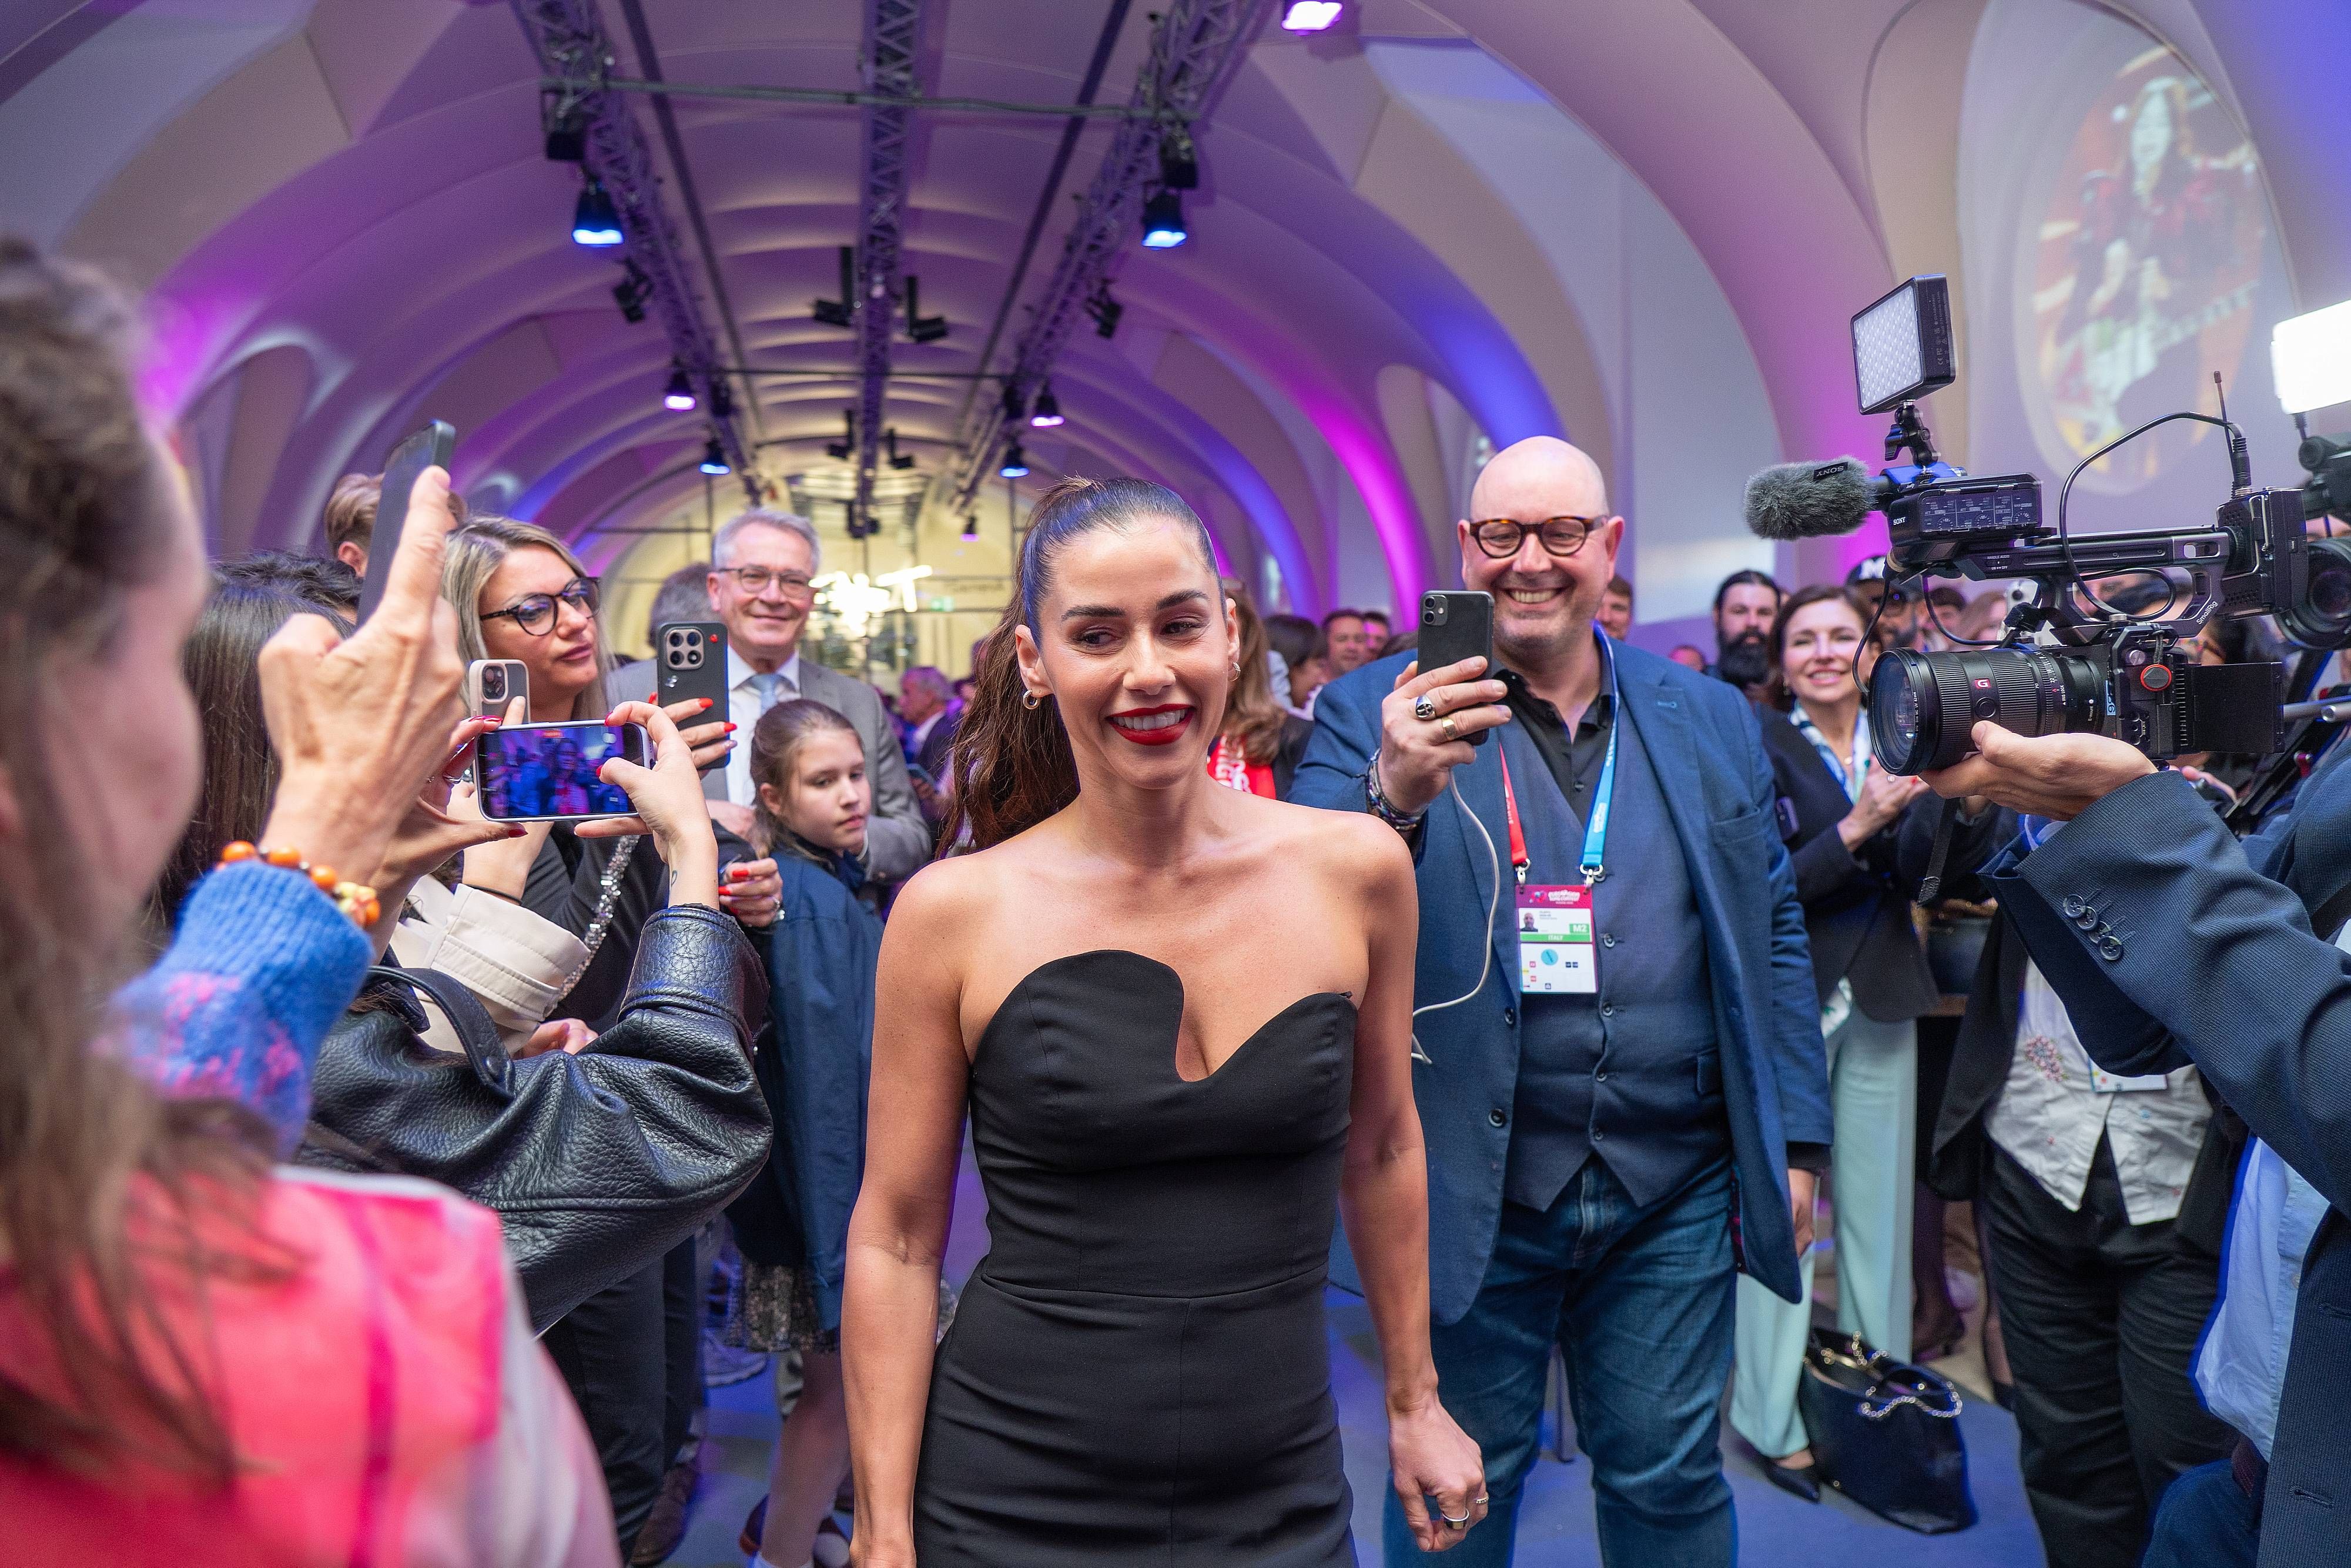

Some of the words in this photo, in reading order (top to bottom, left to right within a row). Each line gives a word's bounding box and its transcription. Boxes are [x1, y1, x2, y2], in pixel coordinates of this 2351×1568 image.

[1816, 465, 1844, 477] SONY
[1893, 517, 1905, 525] SONY
[2196, 601, 2218, 625] SmallRig
[1977, 679, 1988, 688] G
